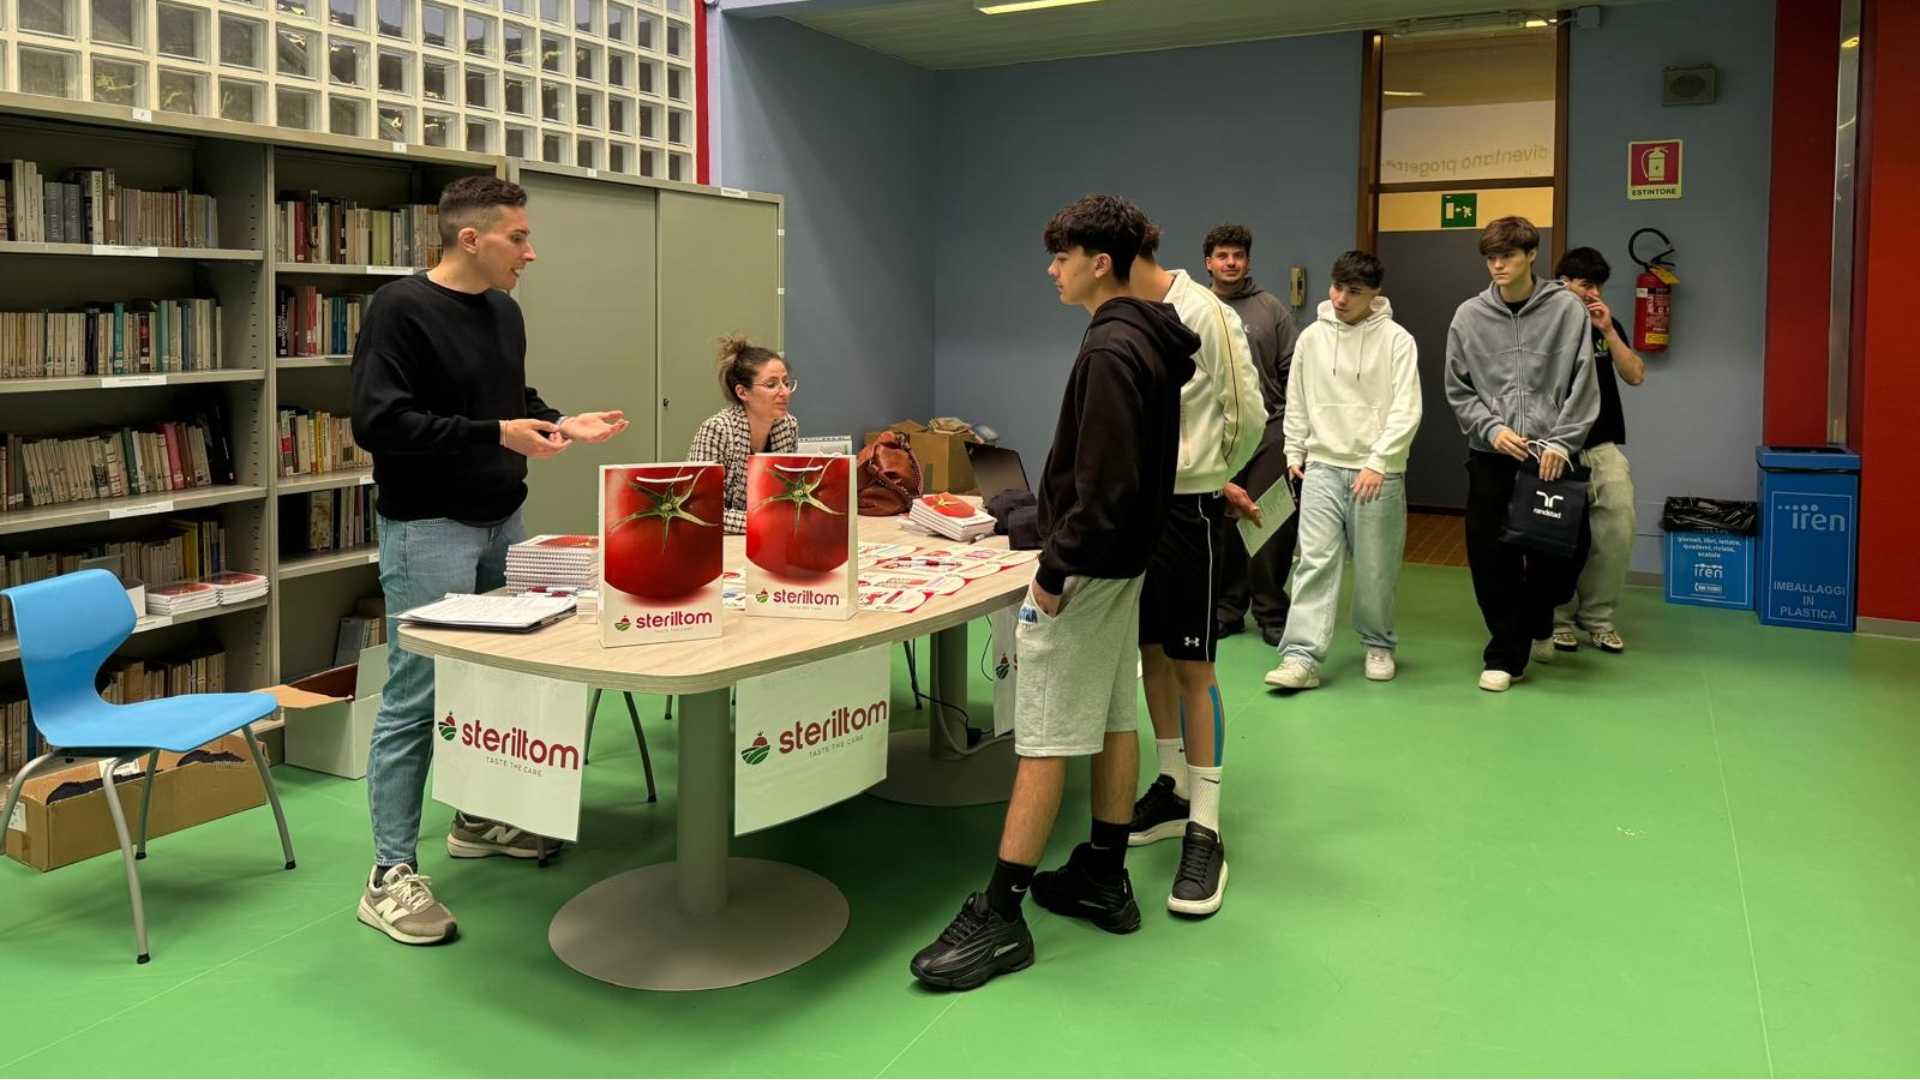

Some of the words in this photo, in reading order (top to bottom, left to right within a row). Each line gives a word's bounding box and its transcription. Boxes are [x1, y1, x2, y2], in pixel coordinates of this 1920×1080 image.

[1632, 188, 1677, 197] ESTINTORE
[1791, 504, 1846, 533] iren
[1693, 564, 1724, 579] iren
[772, 588, 840, 606] steriltom
[1773, 580, 1846, 597] IMBALLAGGI
[1802, 595, 1815, 607] IN
[635, 611, 713, 630] steriltom
[1779, 606, 1838, 620] PLASTICA
[778, 699, 888, 755] steriltom
[461, 719, 580, 771] steriltom
[809, 747, 830, 760] TASTE
[831, 741, 845, 751] THE
[485, 756, 508, 768] TASTE
[509, 761, 522, 773] THE
[523, 766, 544, 778] CARE
